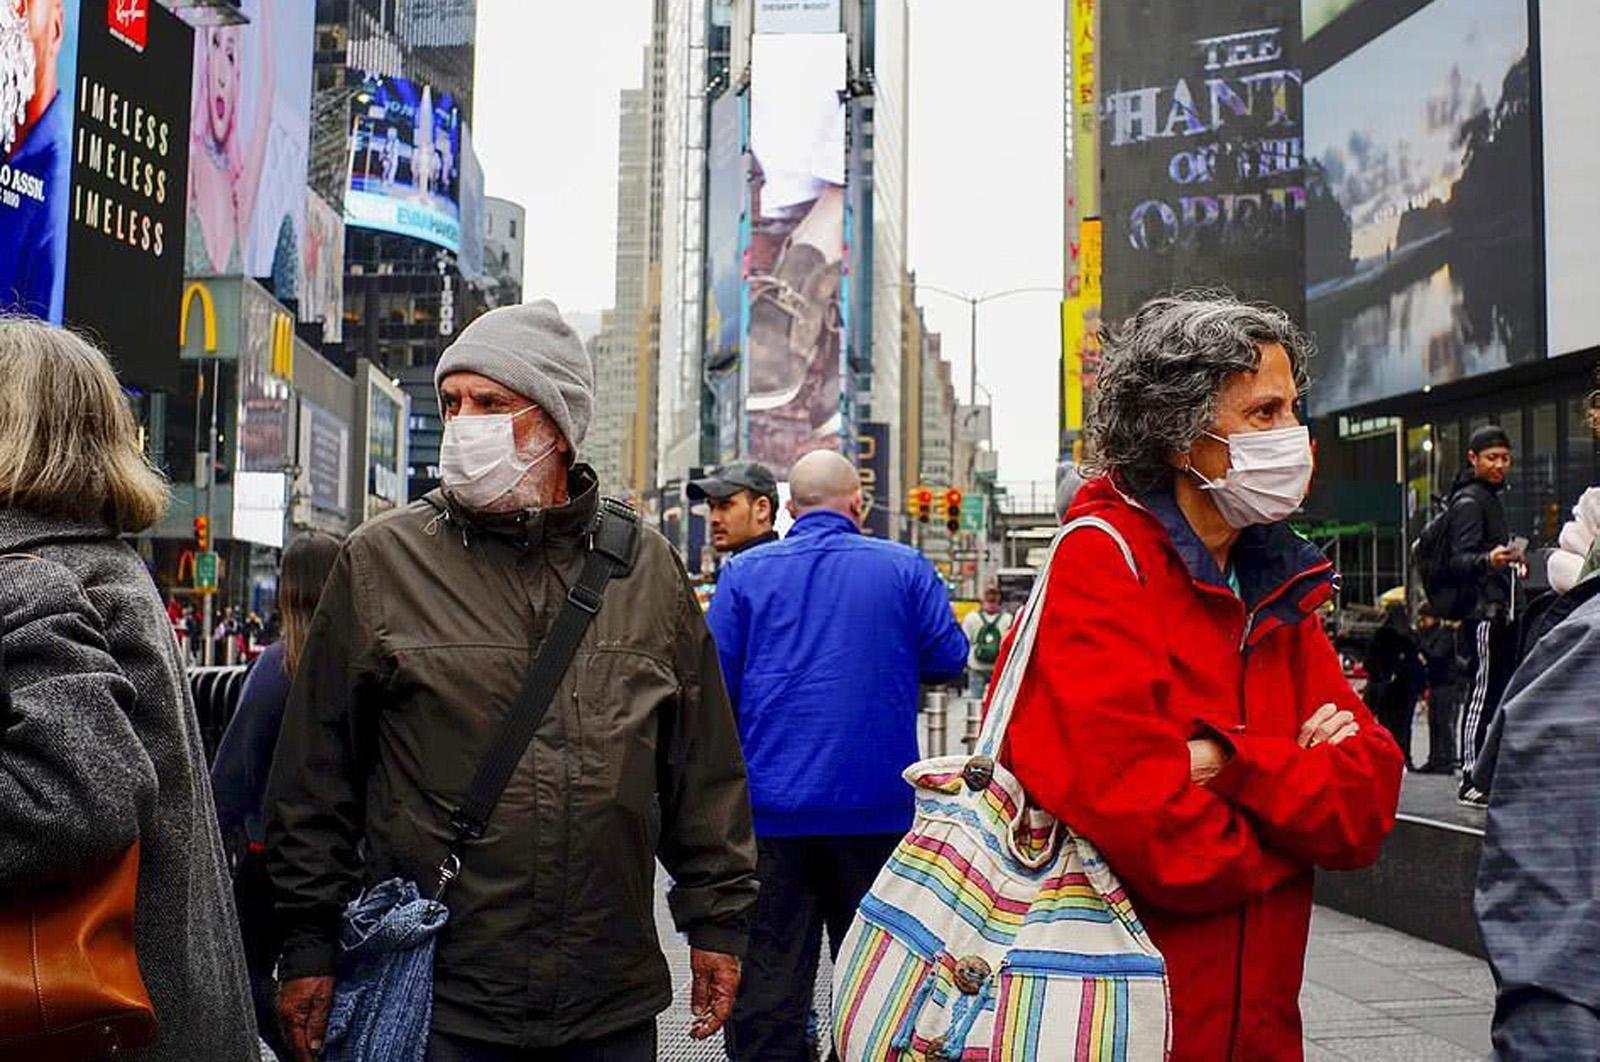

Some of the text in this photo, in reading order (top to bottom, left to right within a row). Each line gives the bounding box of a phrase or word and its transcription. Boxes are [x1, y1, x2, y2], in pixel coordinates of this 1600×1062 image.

[80, 76, 169, 157] IMELESS
[1100, 69, 1301, 147] HANT
[77, 128, 166, 204] IMELESS
[74, 186, 164, 257] IMELESS
